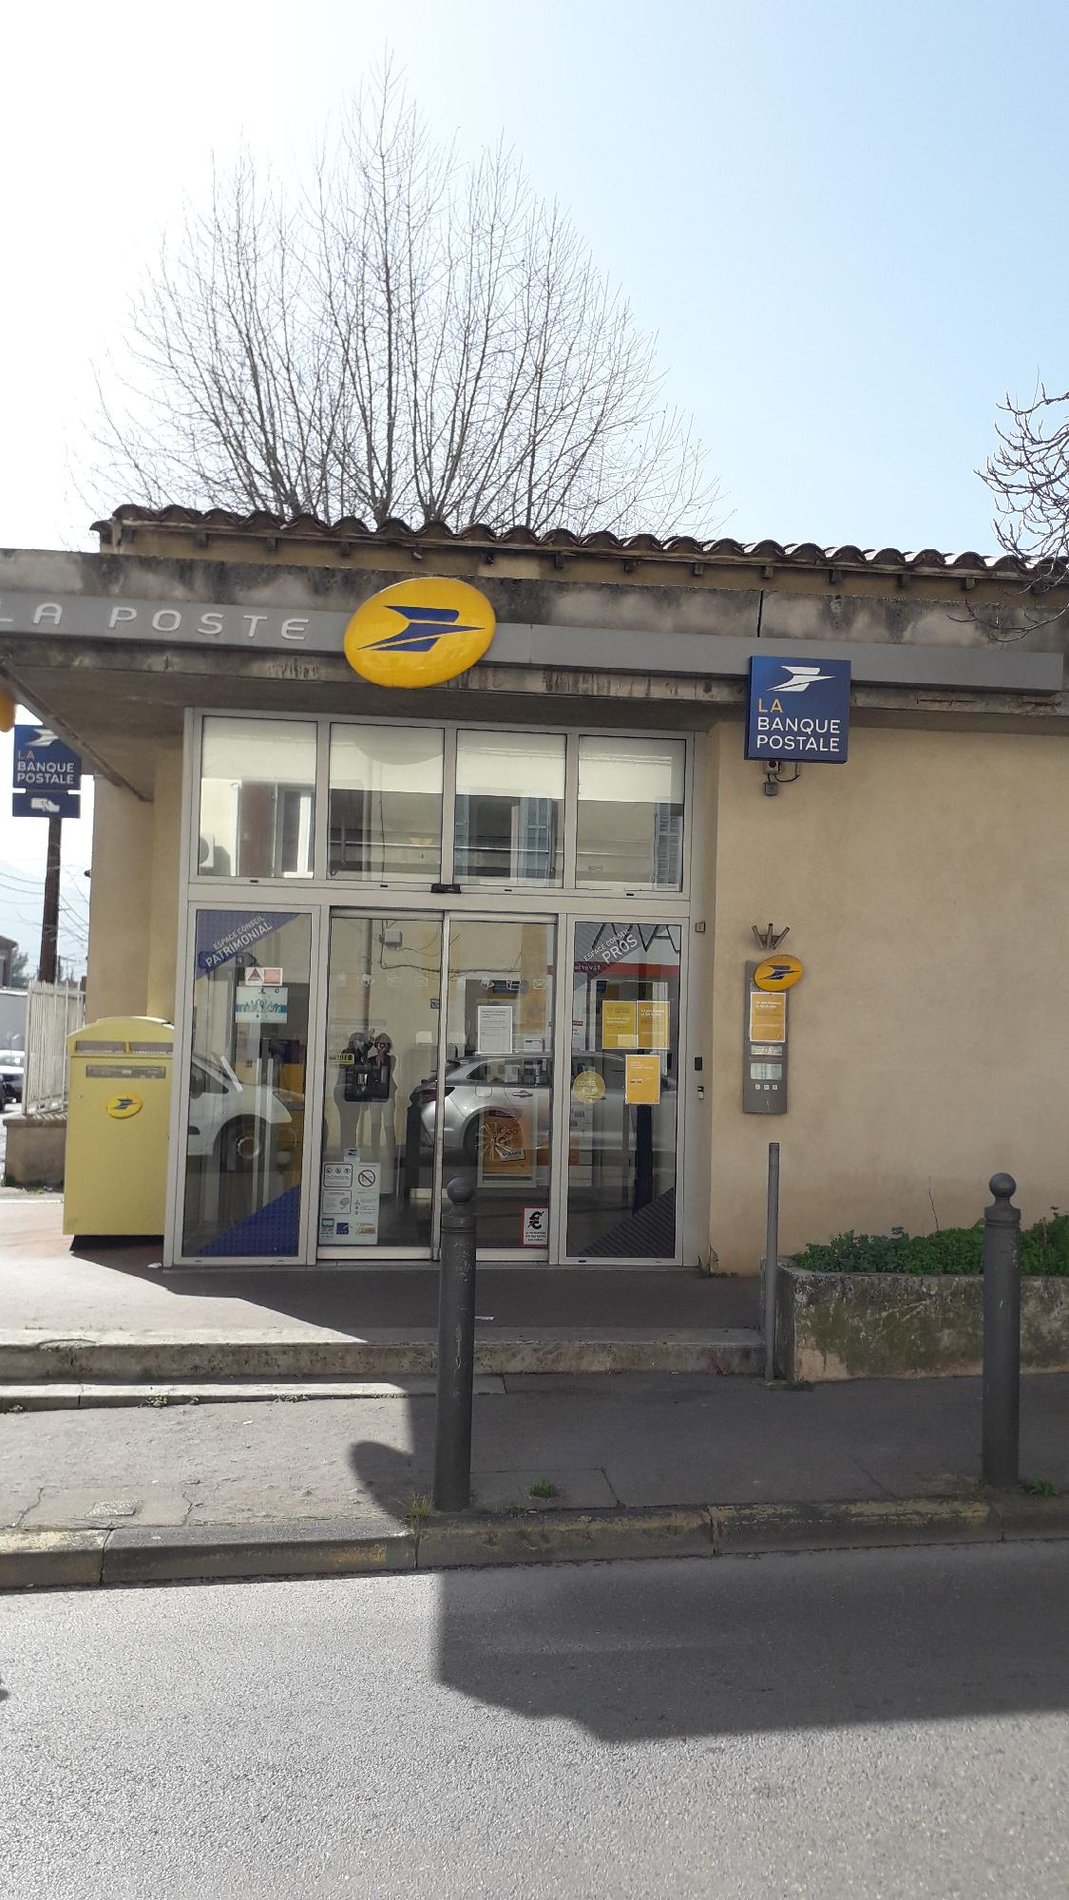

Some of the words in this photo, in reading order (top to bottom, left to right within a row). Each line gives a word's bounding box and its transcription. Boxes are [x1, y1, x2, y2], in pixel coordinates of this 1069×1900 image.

[108, 606, 310, 640] POSTE
[758, 698, 783, 713] LA
[757, 716, 841, 735] BANQUE
[757, 735, 840, 752] POSTALE
[18, 750, 35, 760] LA
[17, 760, 75, 773] BANQUE
[17, 772, 75, 784] POSTALE
[205, 921, 273, 967] PATRIMONIAL
[602, 934, 638, 965] PROS
